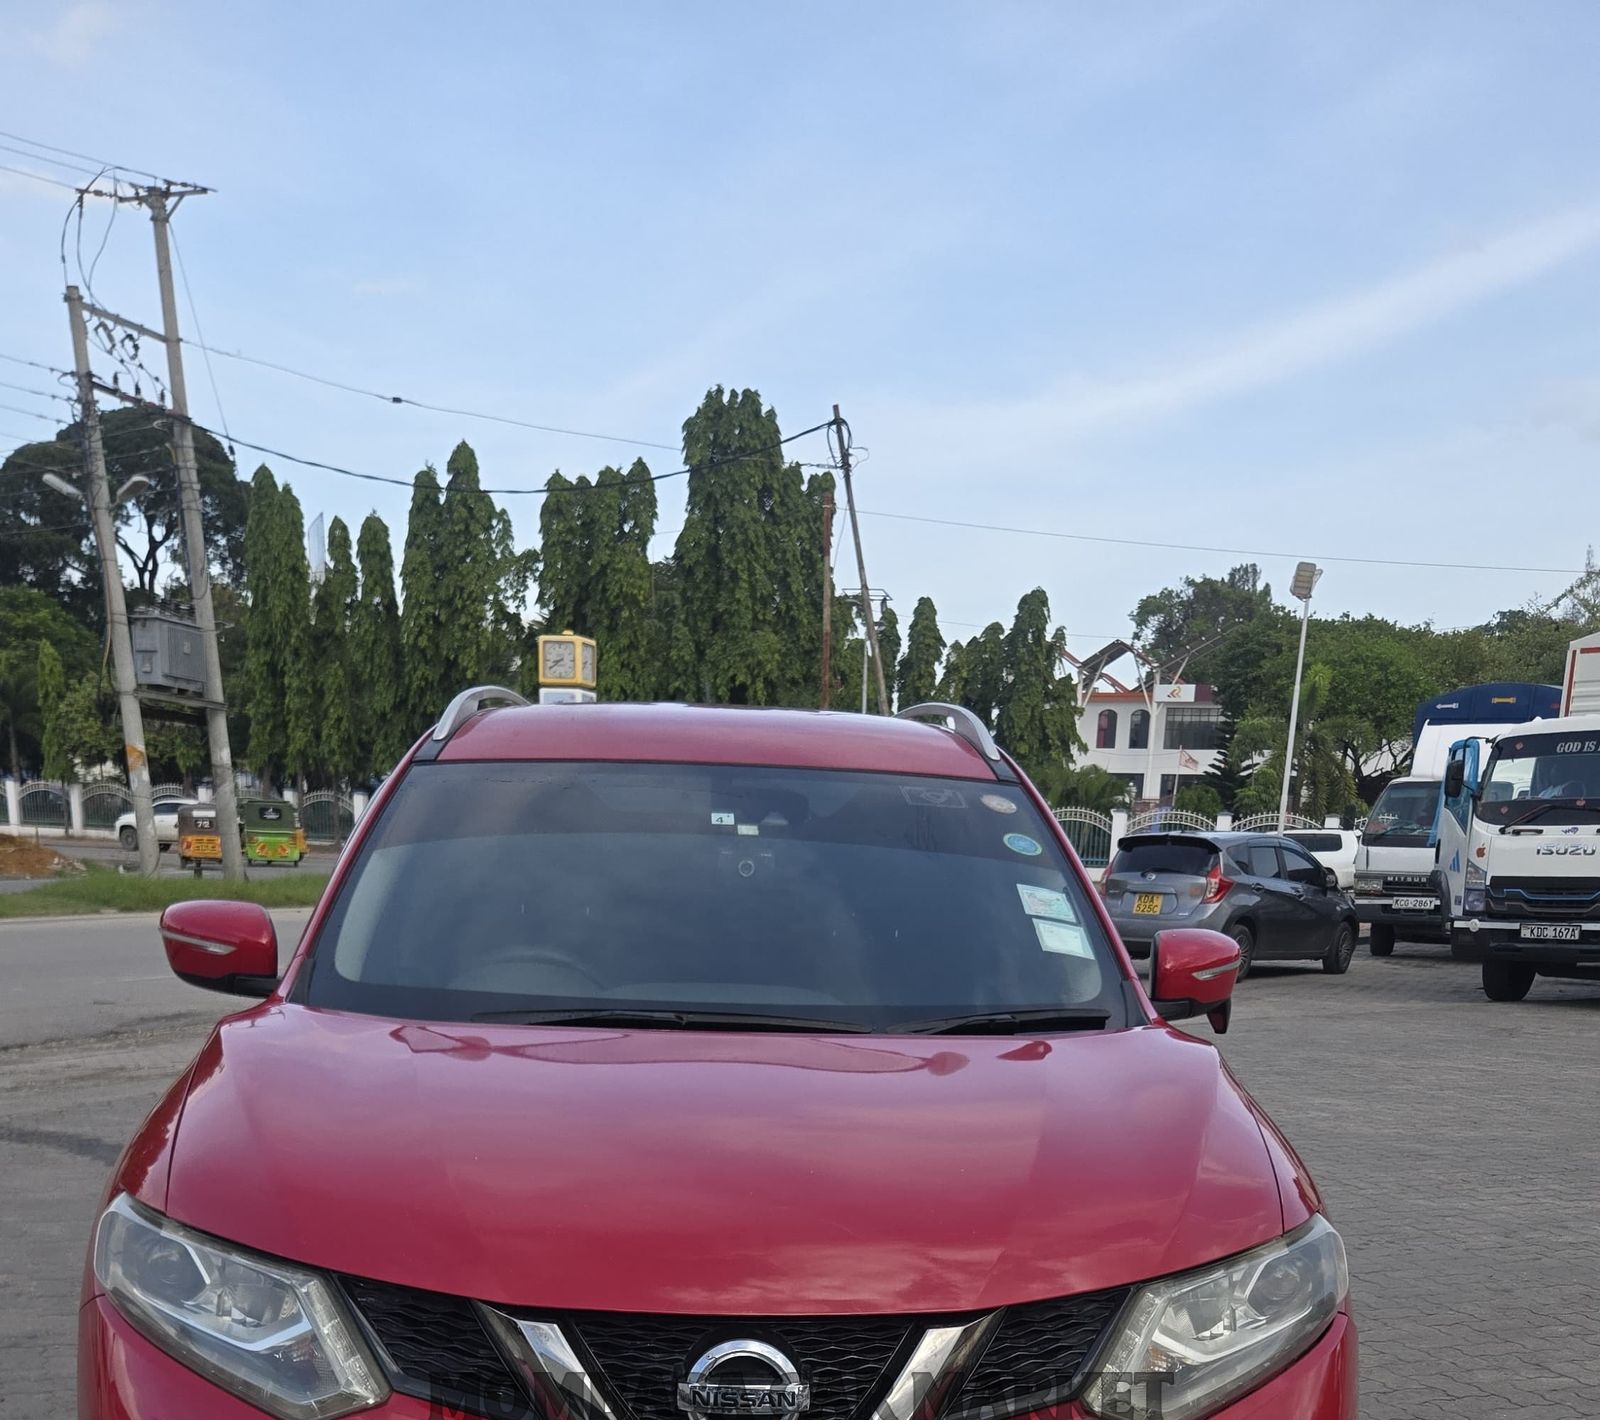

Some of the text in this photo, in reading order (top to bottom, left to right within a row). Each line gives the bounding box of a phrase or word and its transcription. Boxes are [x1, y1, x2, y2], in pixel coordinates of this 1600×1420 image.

[1556, 742, 1581, 753] GOD
[1583, 741, 1597, 752] IS
[1536, 843, 1596, 856] ISUZU
[1137, 894, 1155, 904] KDA
[1135, 904, 1159, 913] 525C
[1530, 926, 1576, 939] KDC 167A
[689, 1385, 797, 1409] NISSAN
